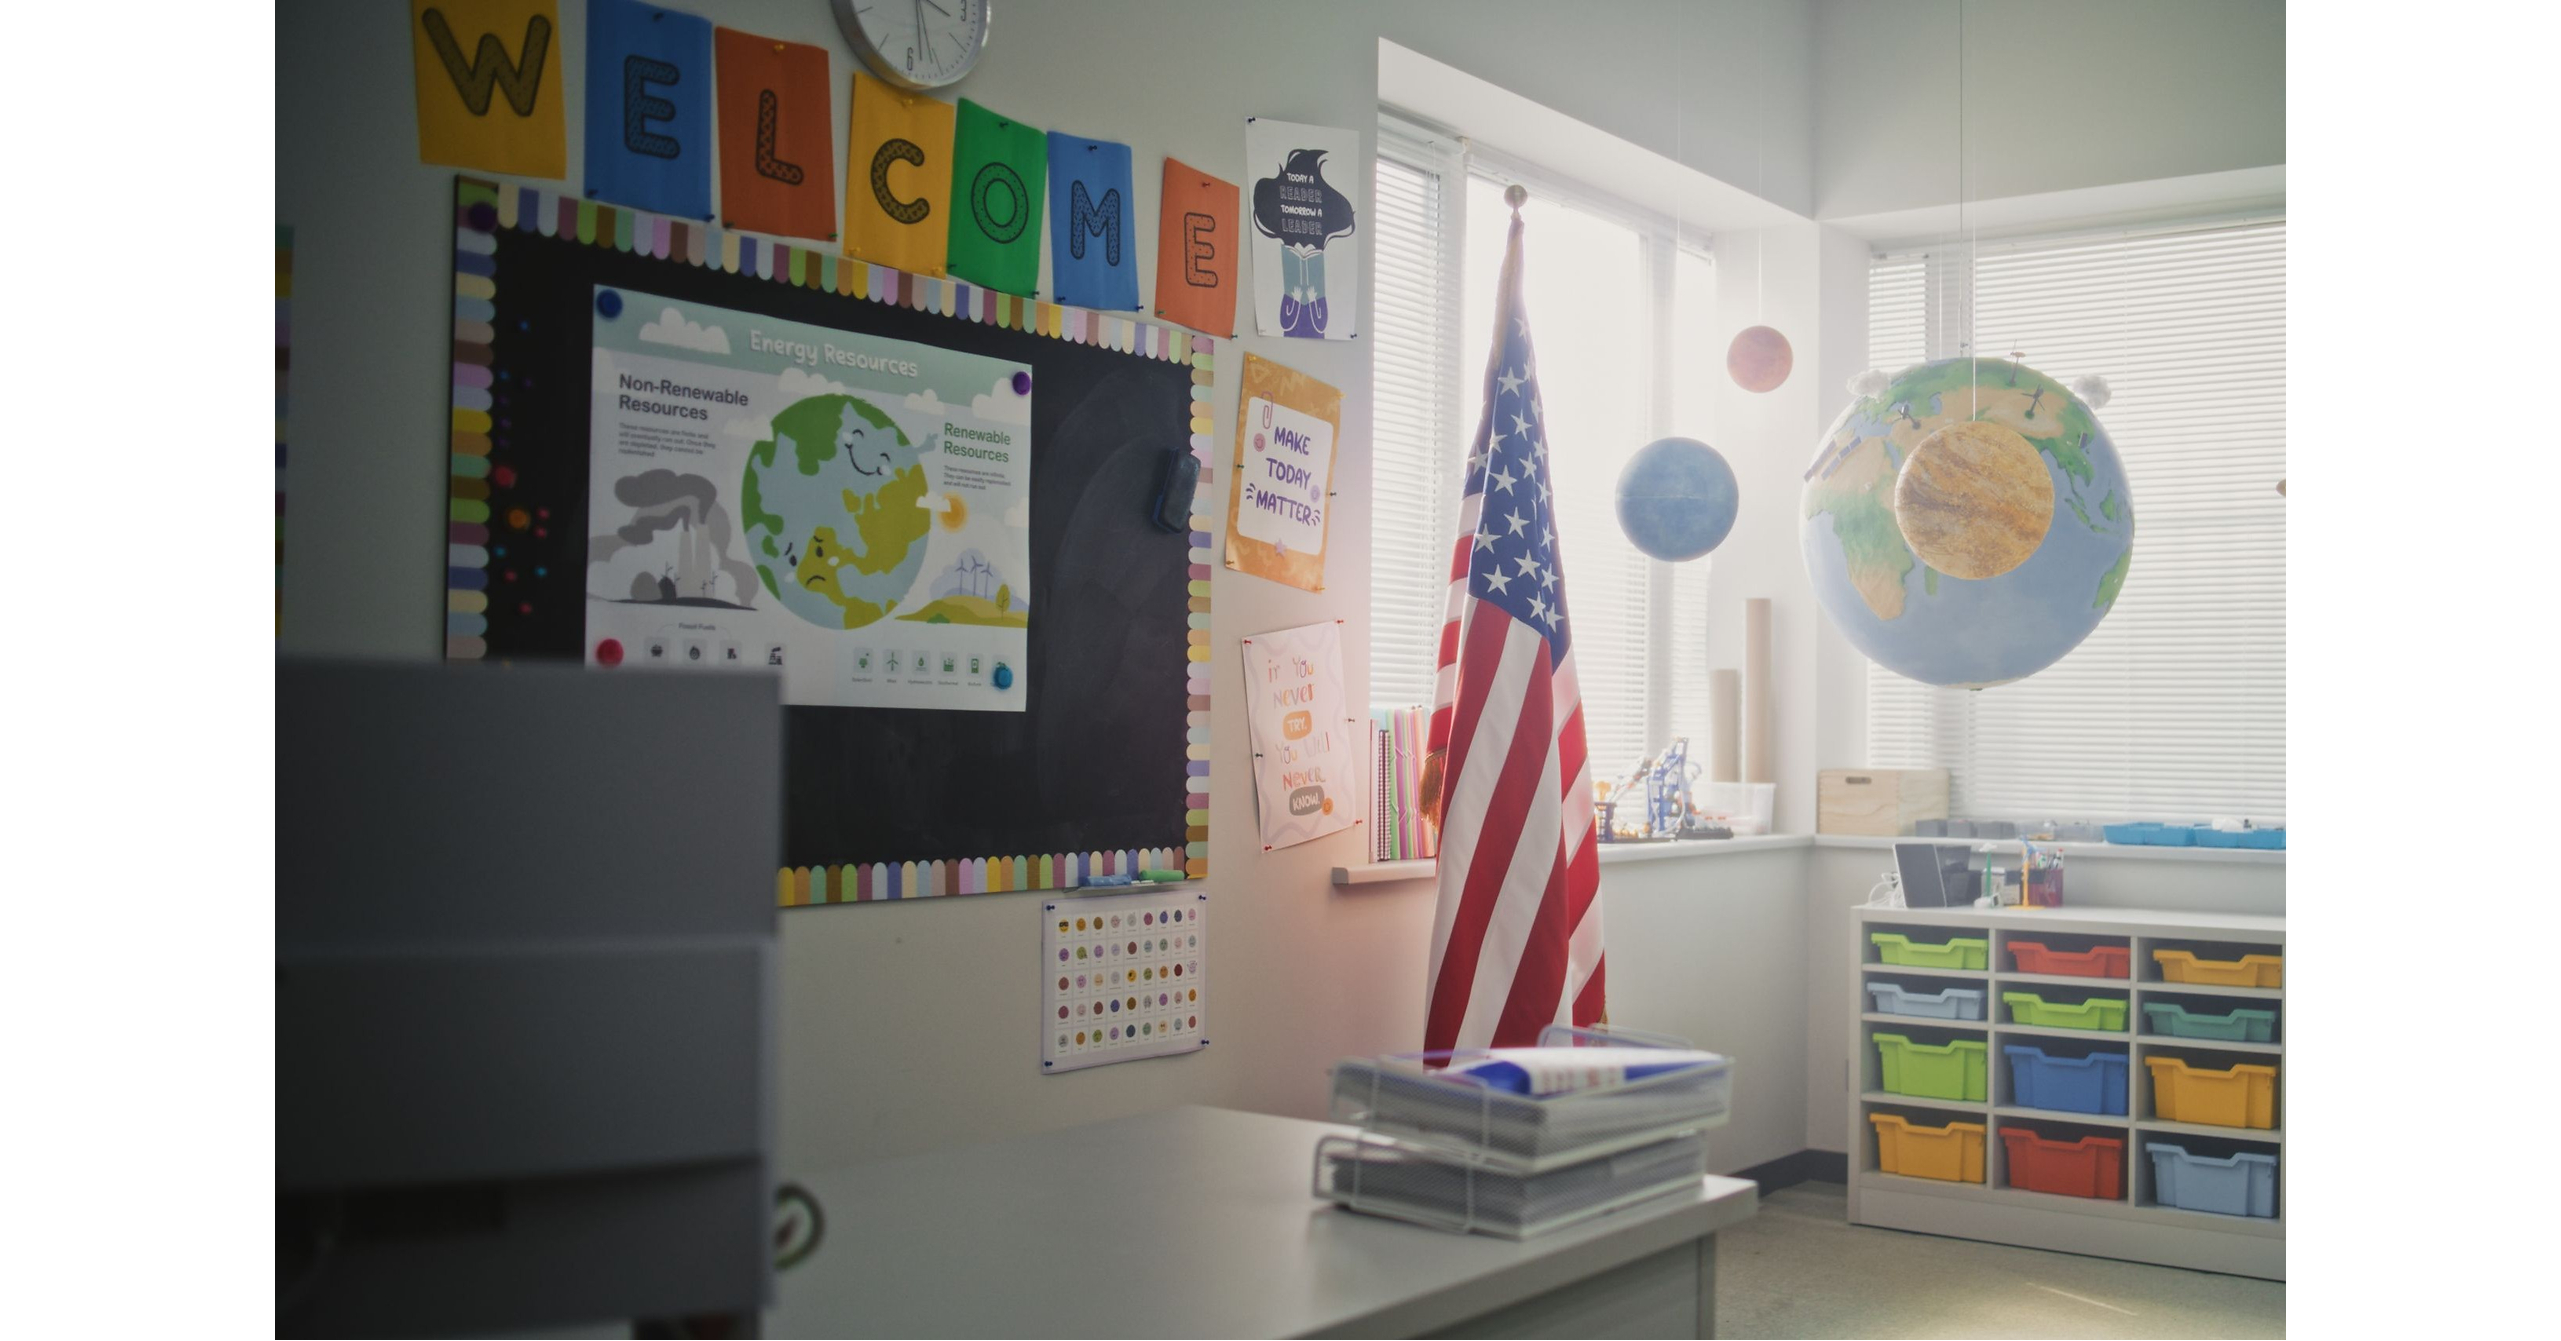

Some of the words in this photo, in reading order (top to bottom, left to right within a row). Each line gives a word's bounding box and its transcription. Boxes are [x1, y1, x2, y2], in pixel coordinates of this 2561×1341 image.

[960, 0, 967, 22] 3
[906, 47, 914, 71] 6
[422, 7, 1219, 288] WELCOME
[1287, 172, 1308, 183] TODAY
[1309, 175, 1314, 184] A
[1279, 185, 1322, 203] READER
[1280, 204, 1316, 217] TOMORROW
[1317, 208, 1323, 217] A
[1281, 218, 1322, 235] LEADER
[750, 329, 818, 366] Energy
[824, 343, 918, 378] Resources
[619, 373, 749, 406] Non-Renewable
[619, 394, 708, 420] Resources
[944, 422, 1011, 445] Renewable
[1274, 426, 1311, 455] MAKE
[944, 440, 1009, 463] Resources
[1266, 457, 1311, 490] TODAY
[1256, 489, 1311, 526] MATTER
[1287, 717, 1307, 732] TRY.
